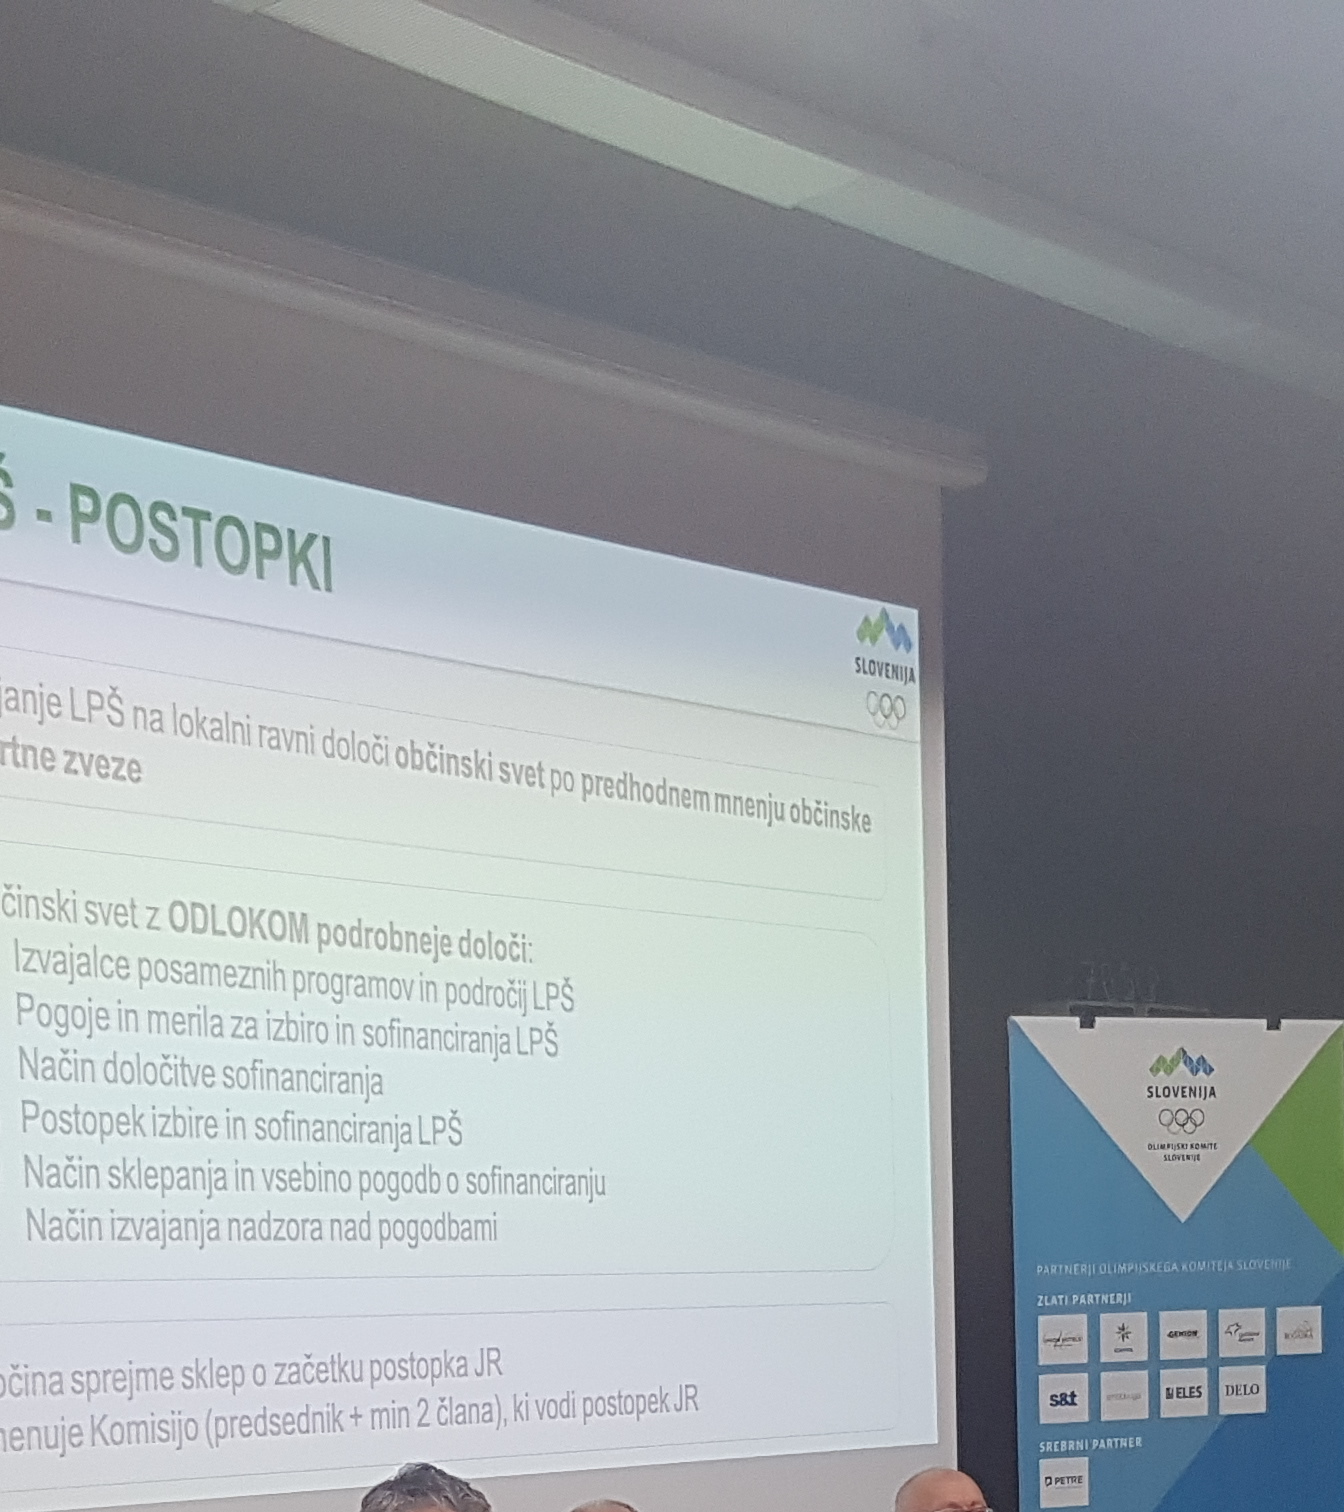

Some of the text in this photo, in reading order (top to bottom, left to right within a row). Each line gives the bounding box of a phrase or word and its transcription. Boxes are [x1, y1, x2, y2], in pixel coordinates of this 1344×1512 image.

[69, 482, 333, 593] POSTOPKI
[855, 657, 915, 684] SLOVENIJA
[63, 746, 142, 784] zveze
[70, 686, 124, 727] LPŠ
[133, 702, 164, 733] na
[173, 702, 251, 747] lokalni
[258, 724, 315, 755] ravni
[322, 728, 389, 766] določi
[395, 740, 492, 782] občinski
[499, 758, 544, 789] svet
[550, 768, 574, 797] po
[581, 769, 709, 813] predhodnem
[714, 791, 785, 828] mnenju
[790, 802, 872, 833] občinske
[85, 898, 138, 929] svet
[146, 906, 160, 931] z
[169, 900, 308, 943] ODLOKOM
[318, 918, 452, 963] podrobneje
[459, 929, 533, 963] določi:
[15, 938, 130, 984] Izvajalce
[139, 957, 286, 992] posameznih
[293, 967, 413, 1004] programov
[420, 972, 438, 1003] in
[446, 977, 527, 1016] področij
[533, 977, 575, 1013] LPŠ
[16, 992, 110, 1039] Pogoje
[118, 999, 138, 1033] in
[148, 1005, 223, 1038] merila
[231, 1014, 258, 1040] za
[267, 1009, 329, 1045] izbiro
[336, 1014, 355, 1046] in
[363, 1018, 510, 1062] sofinanciranja
[516, 1021, 559, 1058] LPŠ
[19, 1045, 95, 1083] Način
[104, 1051, 216, 1090] določitve
[222, 1058, 383, 1104] sofinanciranja
[1147, 1086, 1216, 1100] SLOVENIJA
[21, 1099, 147, 1144] Postopek
[152, 1105, 218, 1139] izbire
[226, 1108, 246, 1140] in
[254, 1110, 413, 1152] sofinanciranja
[418, 1109, 463, 1147] LPŠ
[1148, 1142, 1217, 1151] OLIMPIJSKI KOMITE
[1164, 1153, 1201, 1162] SLOVENIJE
[23, 1154, 100, 1190] Način
[108, 1157, 227, 1200] sklepanja
[235, 1160, 254, 1193] in
[262, 1161, 352, 1194] vsebino
[359, 1163, 441, 1202] pogodb
[446, 1172, 459, 1195] o
[466, 1165, 606, 1203] sofinanciranju
[26, 1207, 102, 1242] Način
[110, 1209, 221, 1250] izvajanja
[228, 1210, 323, 1242] nadzora
[330, 1210, 371, 1242] nad
[378, 1211, 498, 1250] pogodbami
[1037, 1258, 1291, 1277] PARTNERJI OLIMPIJSKEGA KOMITEJA SLOVENIJE
[1037, 1292, 1131, 1307] ZLATI PARTNERJI
[71, 1360, 175, 1402] sprejme
[181, 1357, 246, 1395] sklep
[253, 1364, 266, 1387] o
[274, 1352, 364, 1387] začetku
[369, 1349, 468, 1389] postopka
[474, 1347, 504, 1378] JR
[1176, 1385, 1203, 1399] ELES
[1225, 1383, 1260, 1397] DELO
[90, 1410, 199, 1450] Komisijo
[206, 1402, 344, 1449] (predsednik
[349, 1408, 363, 1425] +
[370, 1400, 411, 1430] min
[416, 1398, 431, 1428] 2
[437, 1394, 507, 1431] člana),
[513, 1392, 529, 1422] ki
[536, 1390, 576, 1421] vodi
[582, 1385, 670, 1425] postopek
[674, 1383, 699, 1413] JR
[1039, 1437, 1142, 1453] SREBRNI PARTNER
[1054, 1475, 1083, 1486] PETRE
